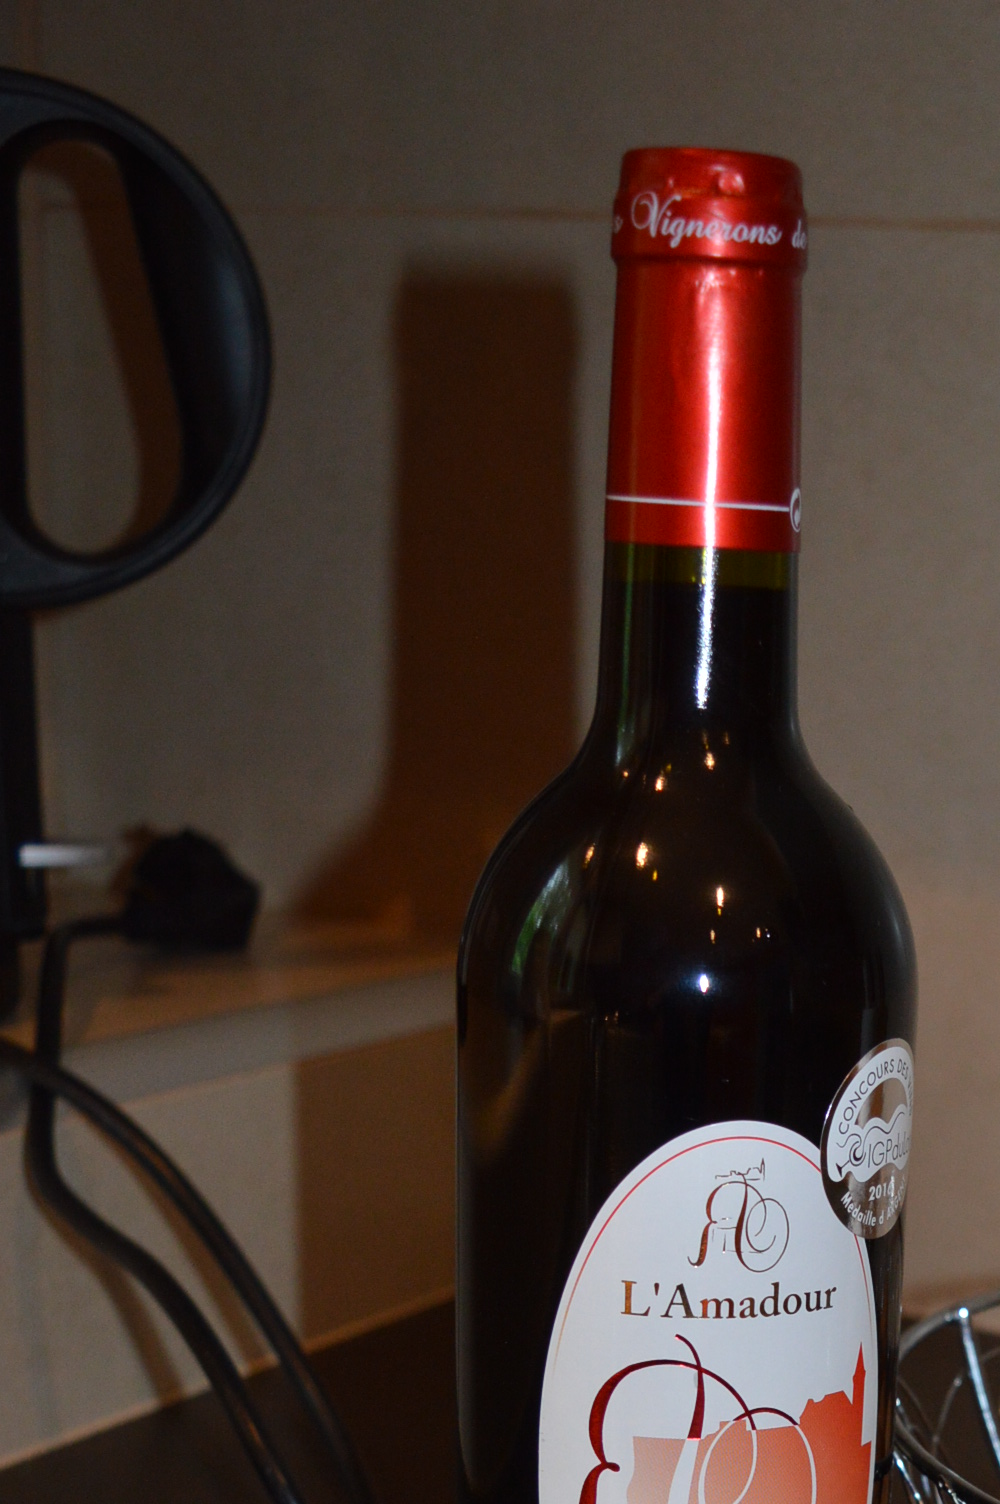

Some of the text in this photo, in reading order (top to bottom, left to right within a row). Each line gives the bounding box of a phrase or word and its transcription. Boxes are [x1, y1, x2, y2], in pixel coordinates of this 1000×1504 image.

[631, 191, 782, 248] Vignerons
[838, 1059, 895, 1135] CONCOURS
[620, 1279, 838, 1320] L'Amadour
